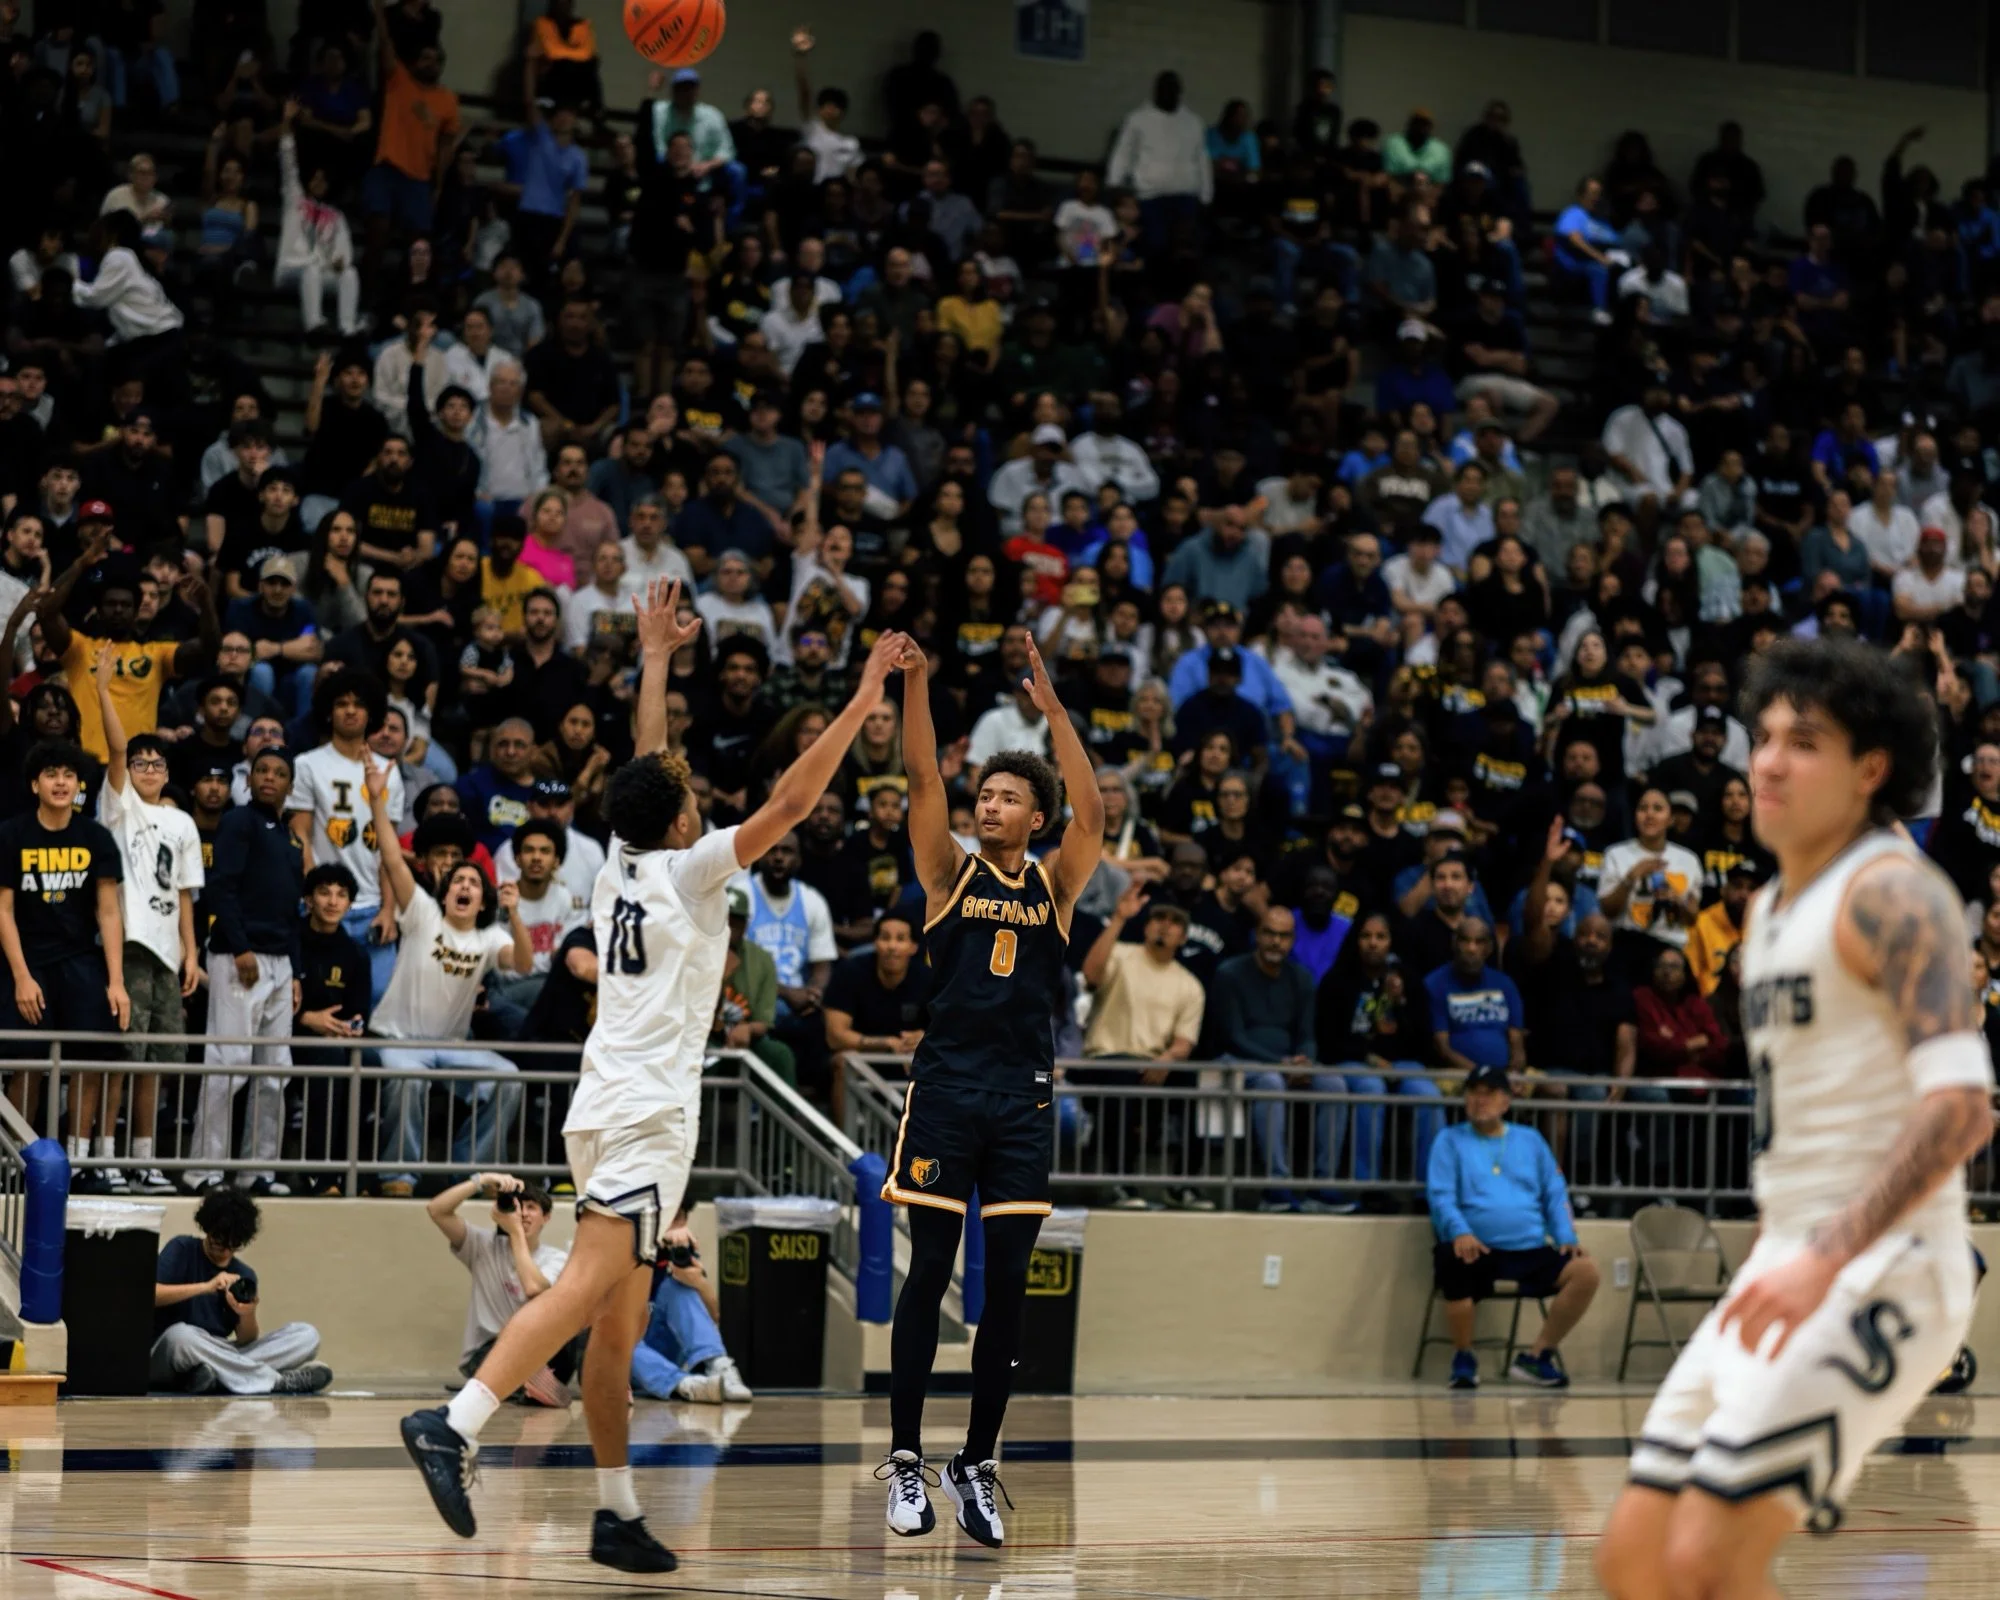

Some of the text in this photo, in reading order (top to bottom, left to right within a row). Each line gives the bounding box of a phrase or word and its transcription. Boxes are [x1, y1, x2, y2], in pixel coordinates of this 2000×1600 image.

[21, 847, 92, 873] FIND
[20, 871, 88, 892] A WAY
[961, 895, 1050, 926] BRENNAN
[606, 894, 647, 975] 10
[989, 928, 1018, 976] 0
[769, 1234, 819, 1260] SAISD
